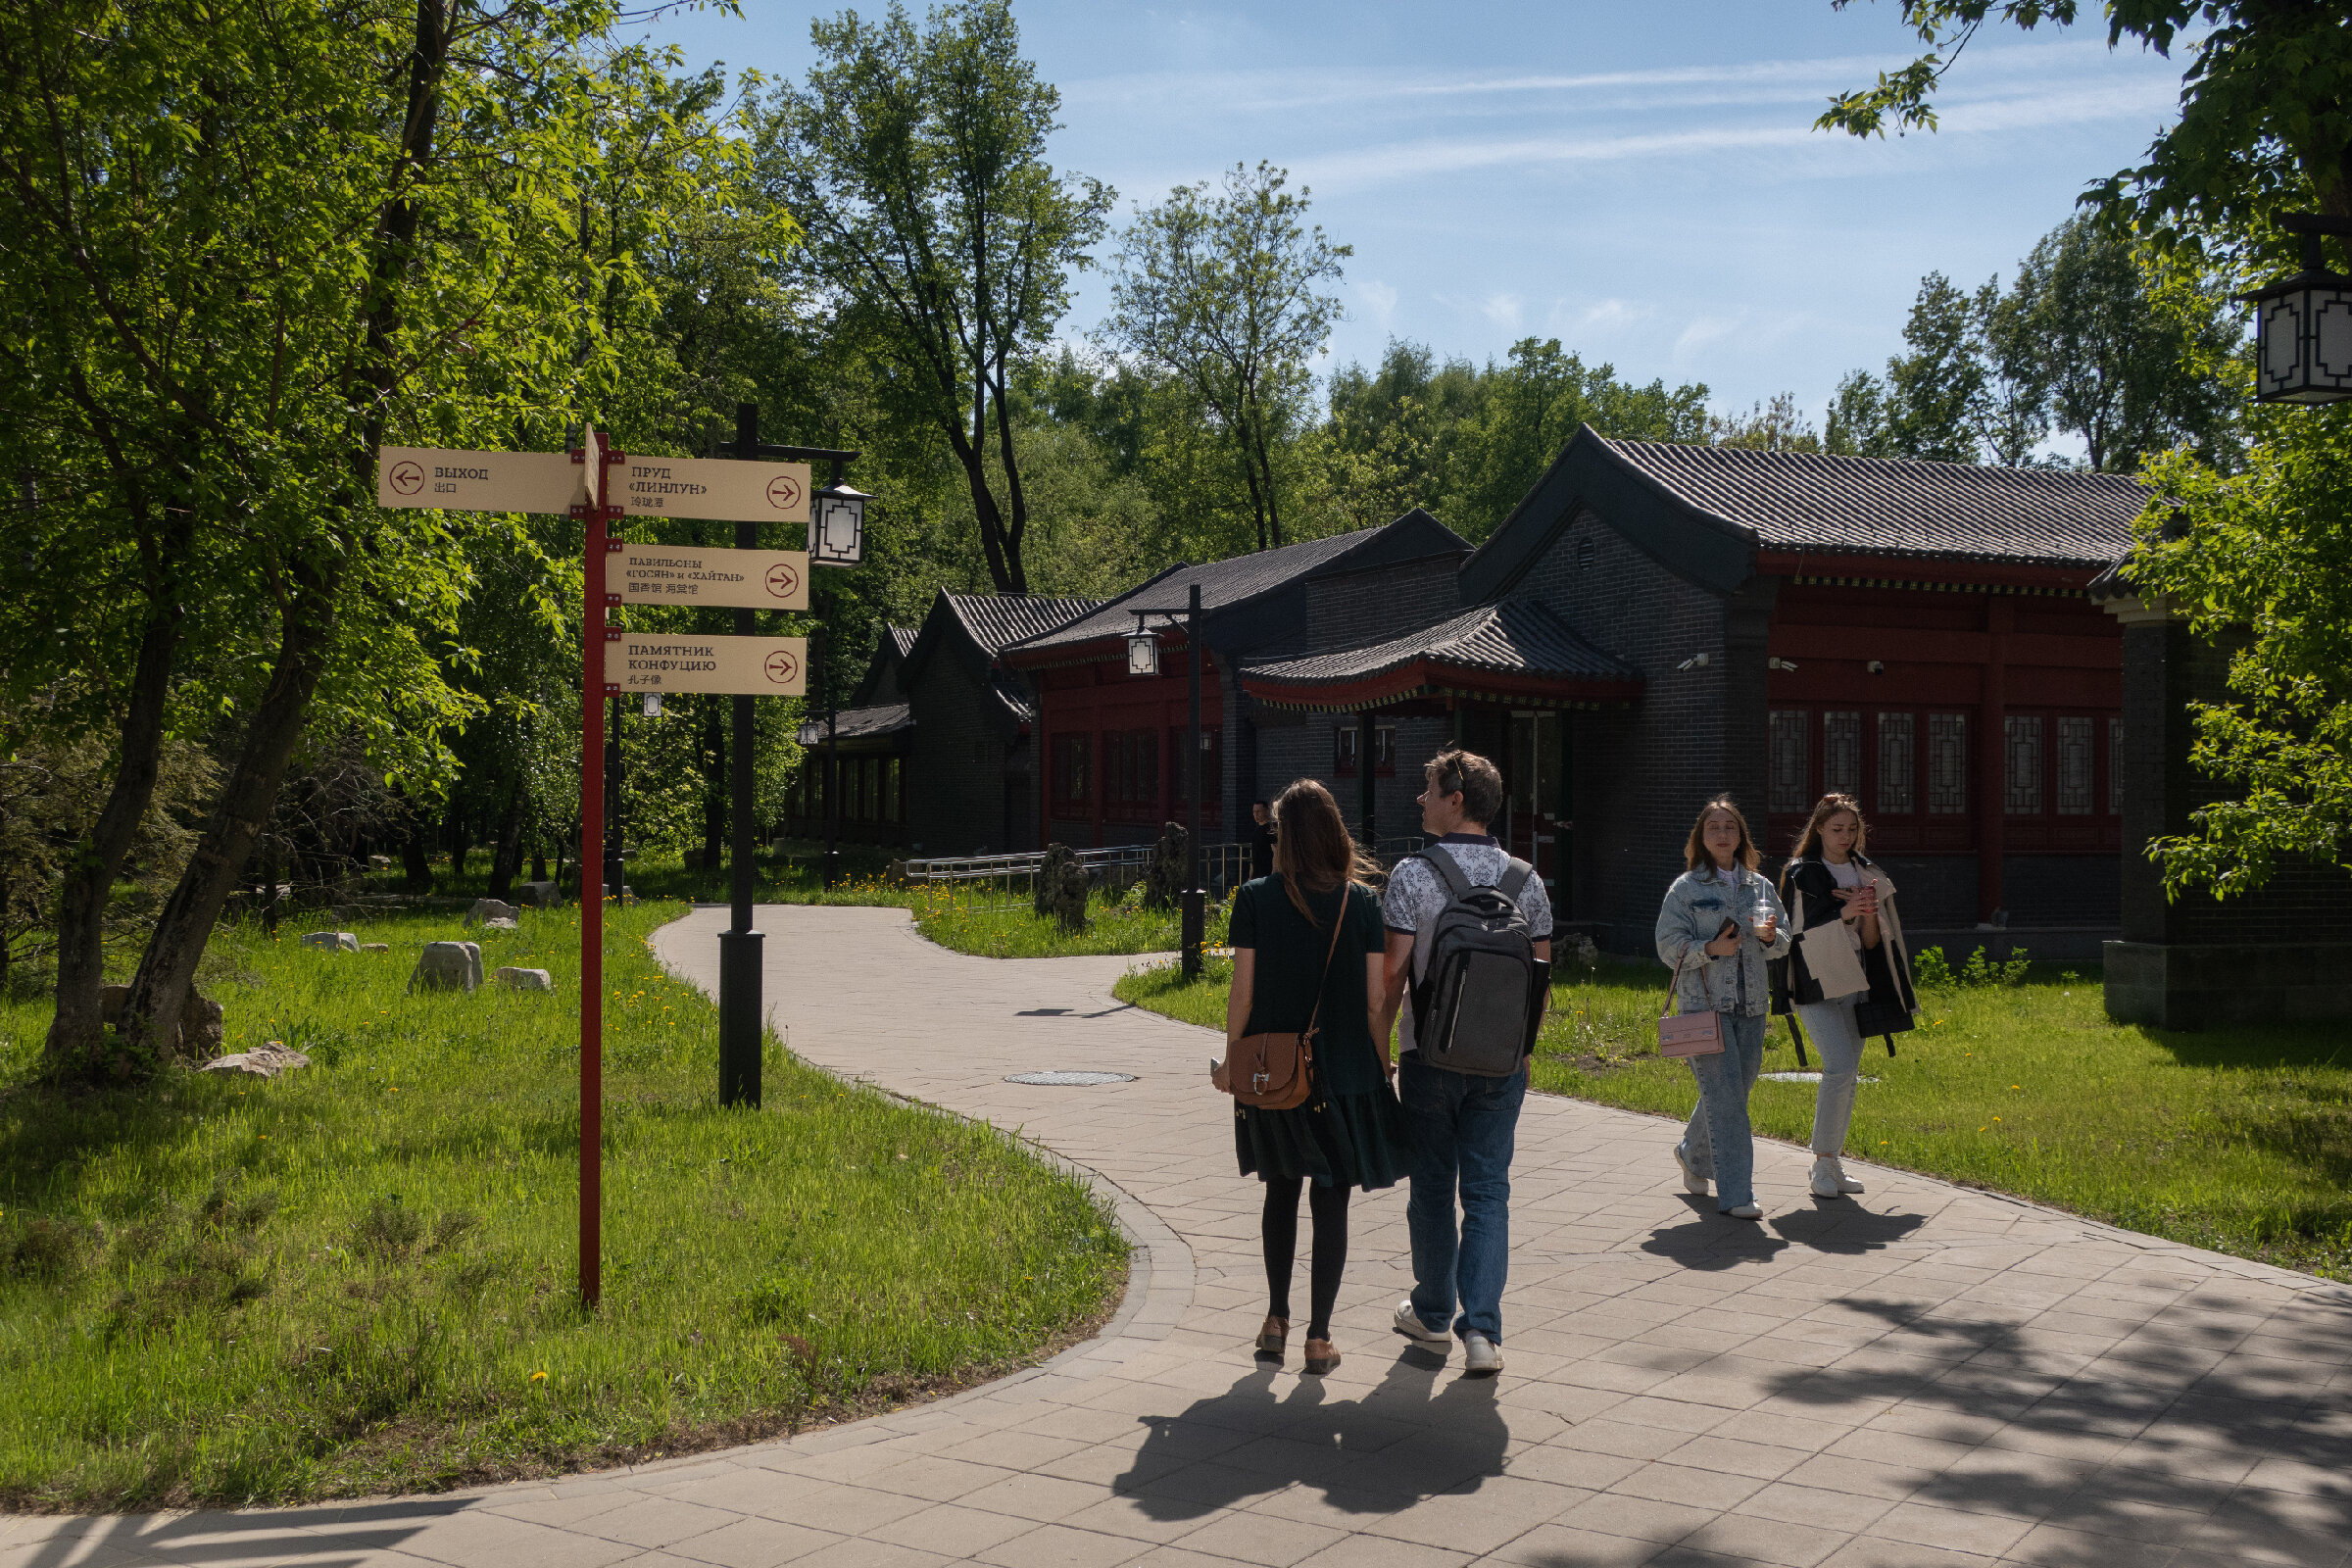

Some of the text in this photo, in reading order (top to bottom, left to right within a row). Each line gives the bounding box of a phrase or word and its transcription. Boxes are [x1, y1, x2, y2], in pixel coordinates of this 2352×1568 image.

[434, 466, 489, 480] ВЫХОД
[632, 466, 670, 479] ПРУД
[434, 482, 457, 493] 出口
[629, 482, 708, 494] «ЛИНЛУН»
[629, 557, 703, 568] ПАВИЛЬОНЫ
[626, 570, 674, 579] «ГОСЯН»
[688, 570, 745, 582] «ХАЙТАН»
[628, 645, 714, 657] ПАМЯТНИК
[628, 661, 715, 671] КОНФУЦИЮ
[628, 675, 662, 685] 孔子像
